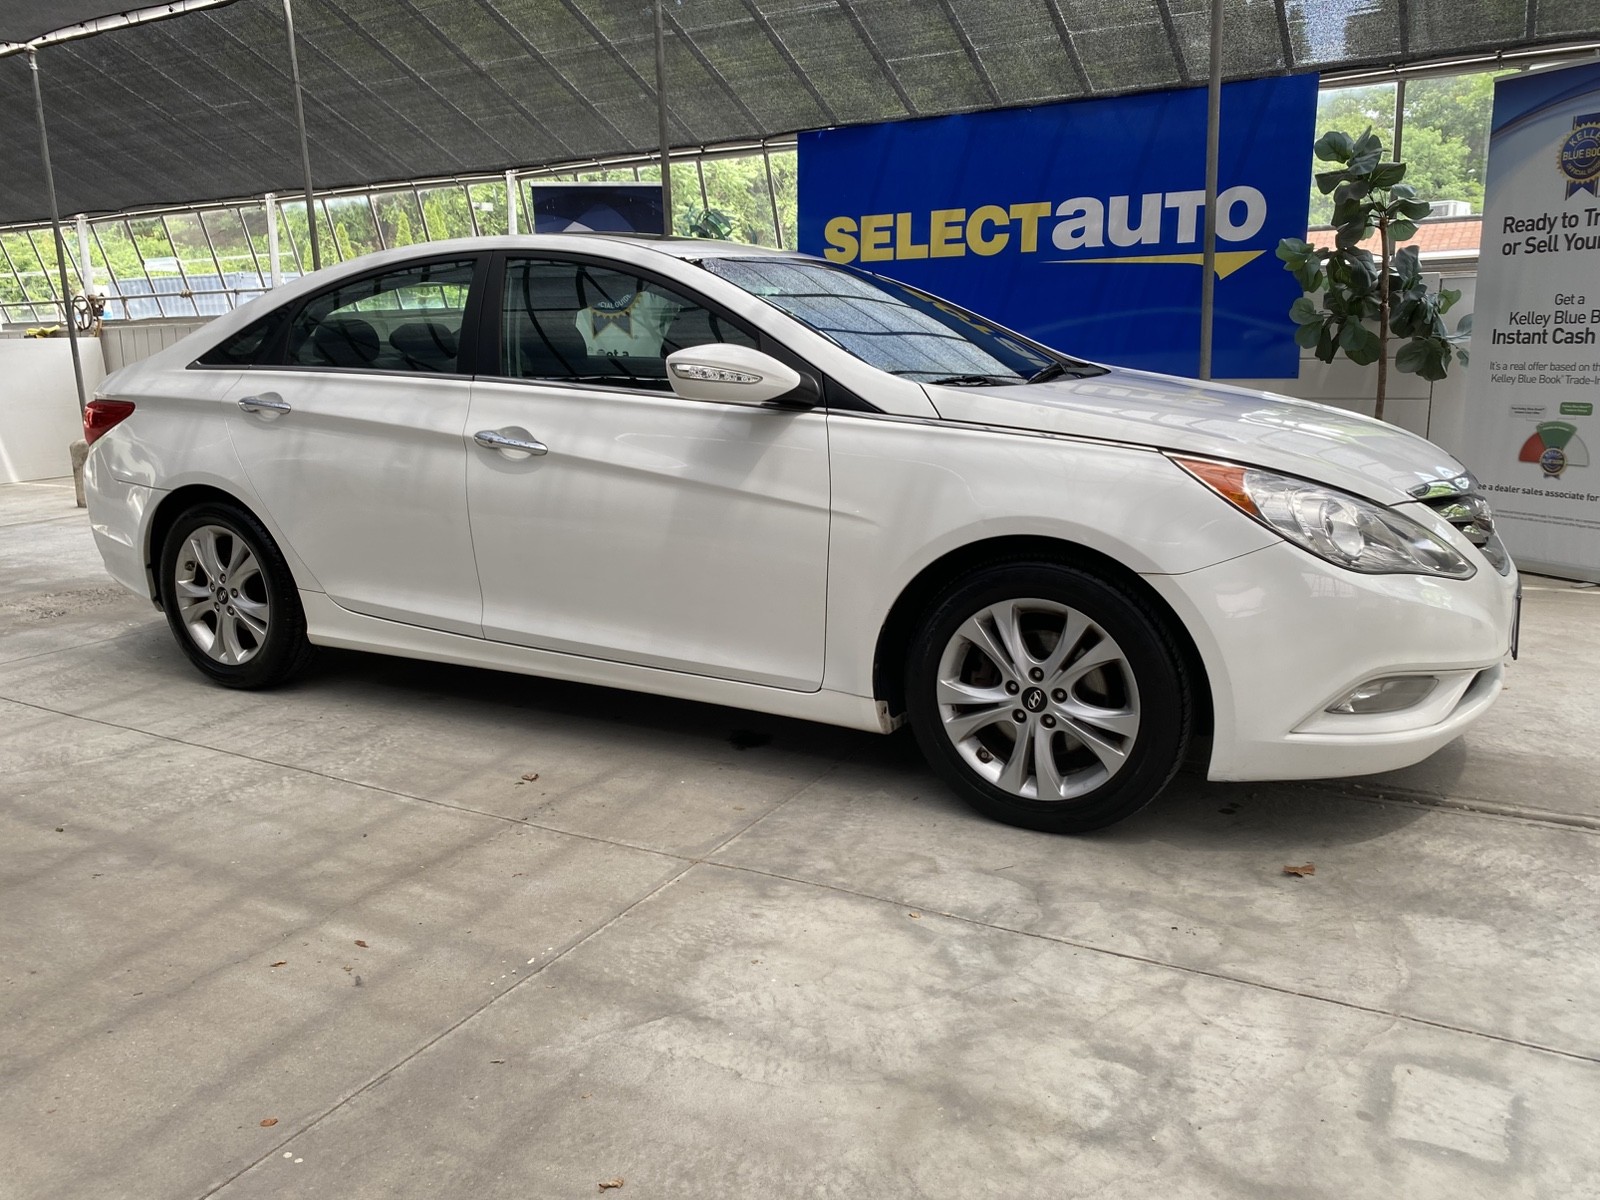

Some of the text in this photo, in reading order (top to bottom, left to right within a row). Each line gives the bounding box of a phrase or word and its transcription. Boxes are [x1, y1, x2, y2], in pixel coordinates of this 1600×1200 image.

[1562, 149, 1585, 161] BLUE
[1503, 213, 1557, 234] Ready
[1561, 212, 1579, 228] to
[1502, 242, 1521, 255] or
[1524, 234, 1559, 254] Sell
[1554, 293, 1585, 305] Get a
[1509, 311, 1551, 328] Kelley
[1554, 310, 1586, 324] Blue
[1492, 327, 1596, 344] Instant Cash
[1490, 361, 1501, 371] It's
[1502, 363, 1508, 371] a
[1509, 362, 1526, 371] real
[1528, 362, 1548, 371] offer
[1550, 362, 1576, 372] based
[1578, 363, 1590, 372] on
[1491, 374, 1516, 385] Kelley
[1517, 374, 1537, 384] Blue
[1494, 484, 1520, 494] dealer
[1521, 486, 1543, 496] sales
[1545, 489, 1585, 501] associate
[1586, 493, 1599, 502] for
